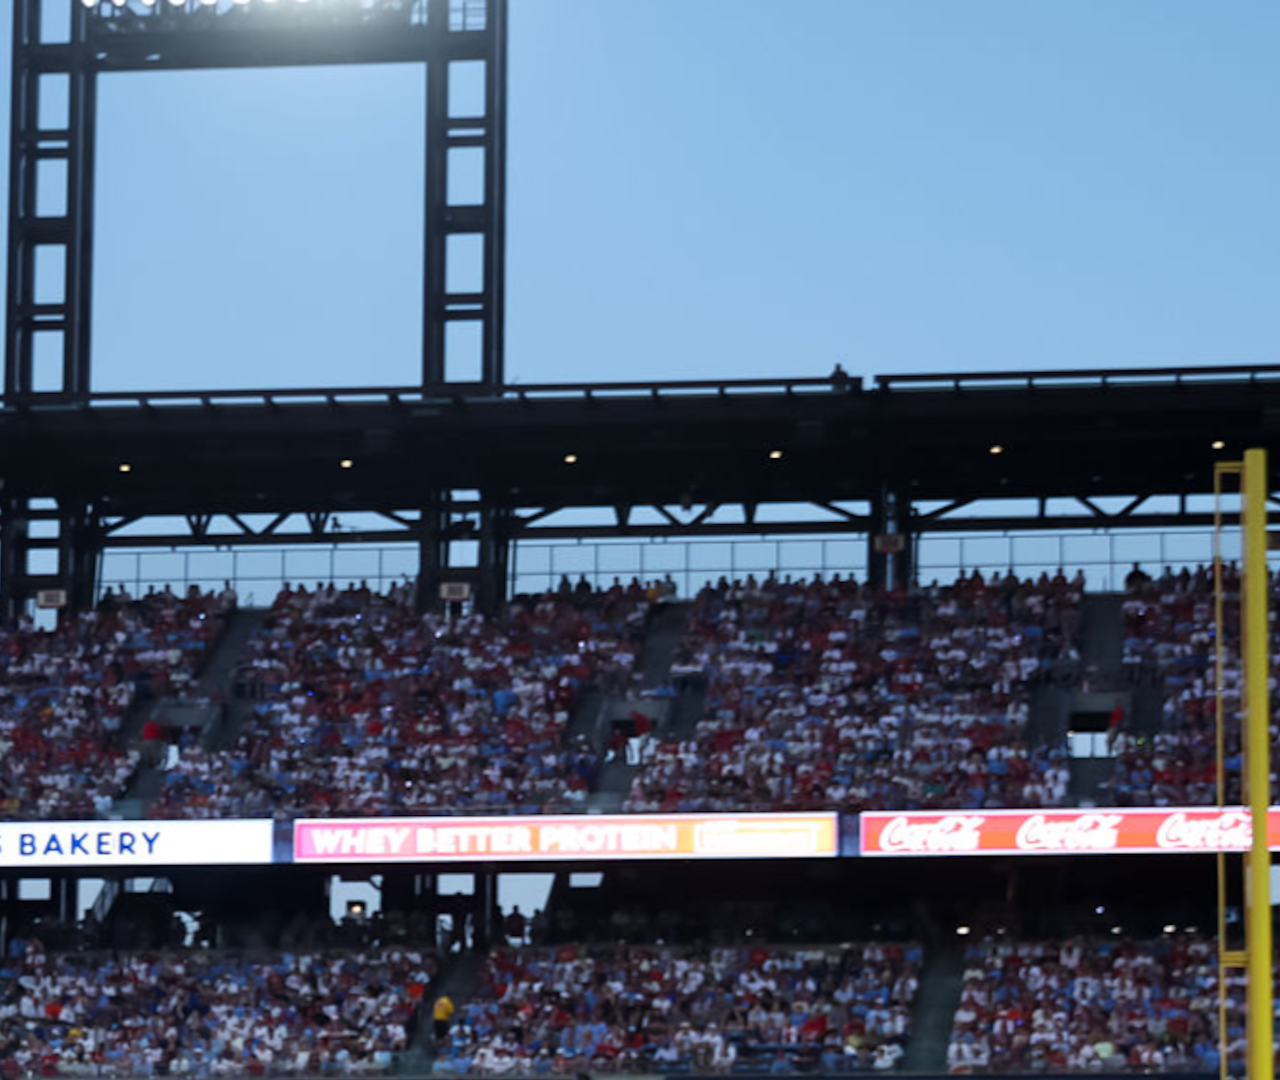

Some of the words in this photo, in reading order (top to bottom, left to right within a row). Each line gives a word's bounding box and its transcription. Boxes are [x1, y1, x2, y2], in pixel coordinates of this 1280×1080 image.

[19, 832, 161, 856] BAKERY
[312, 828, 416, 854] WHEY
[424, 826, 532, 852] BETTER
[540, 823, 676, 850] PROTEIN
